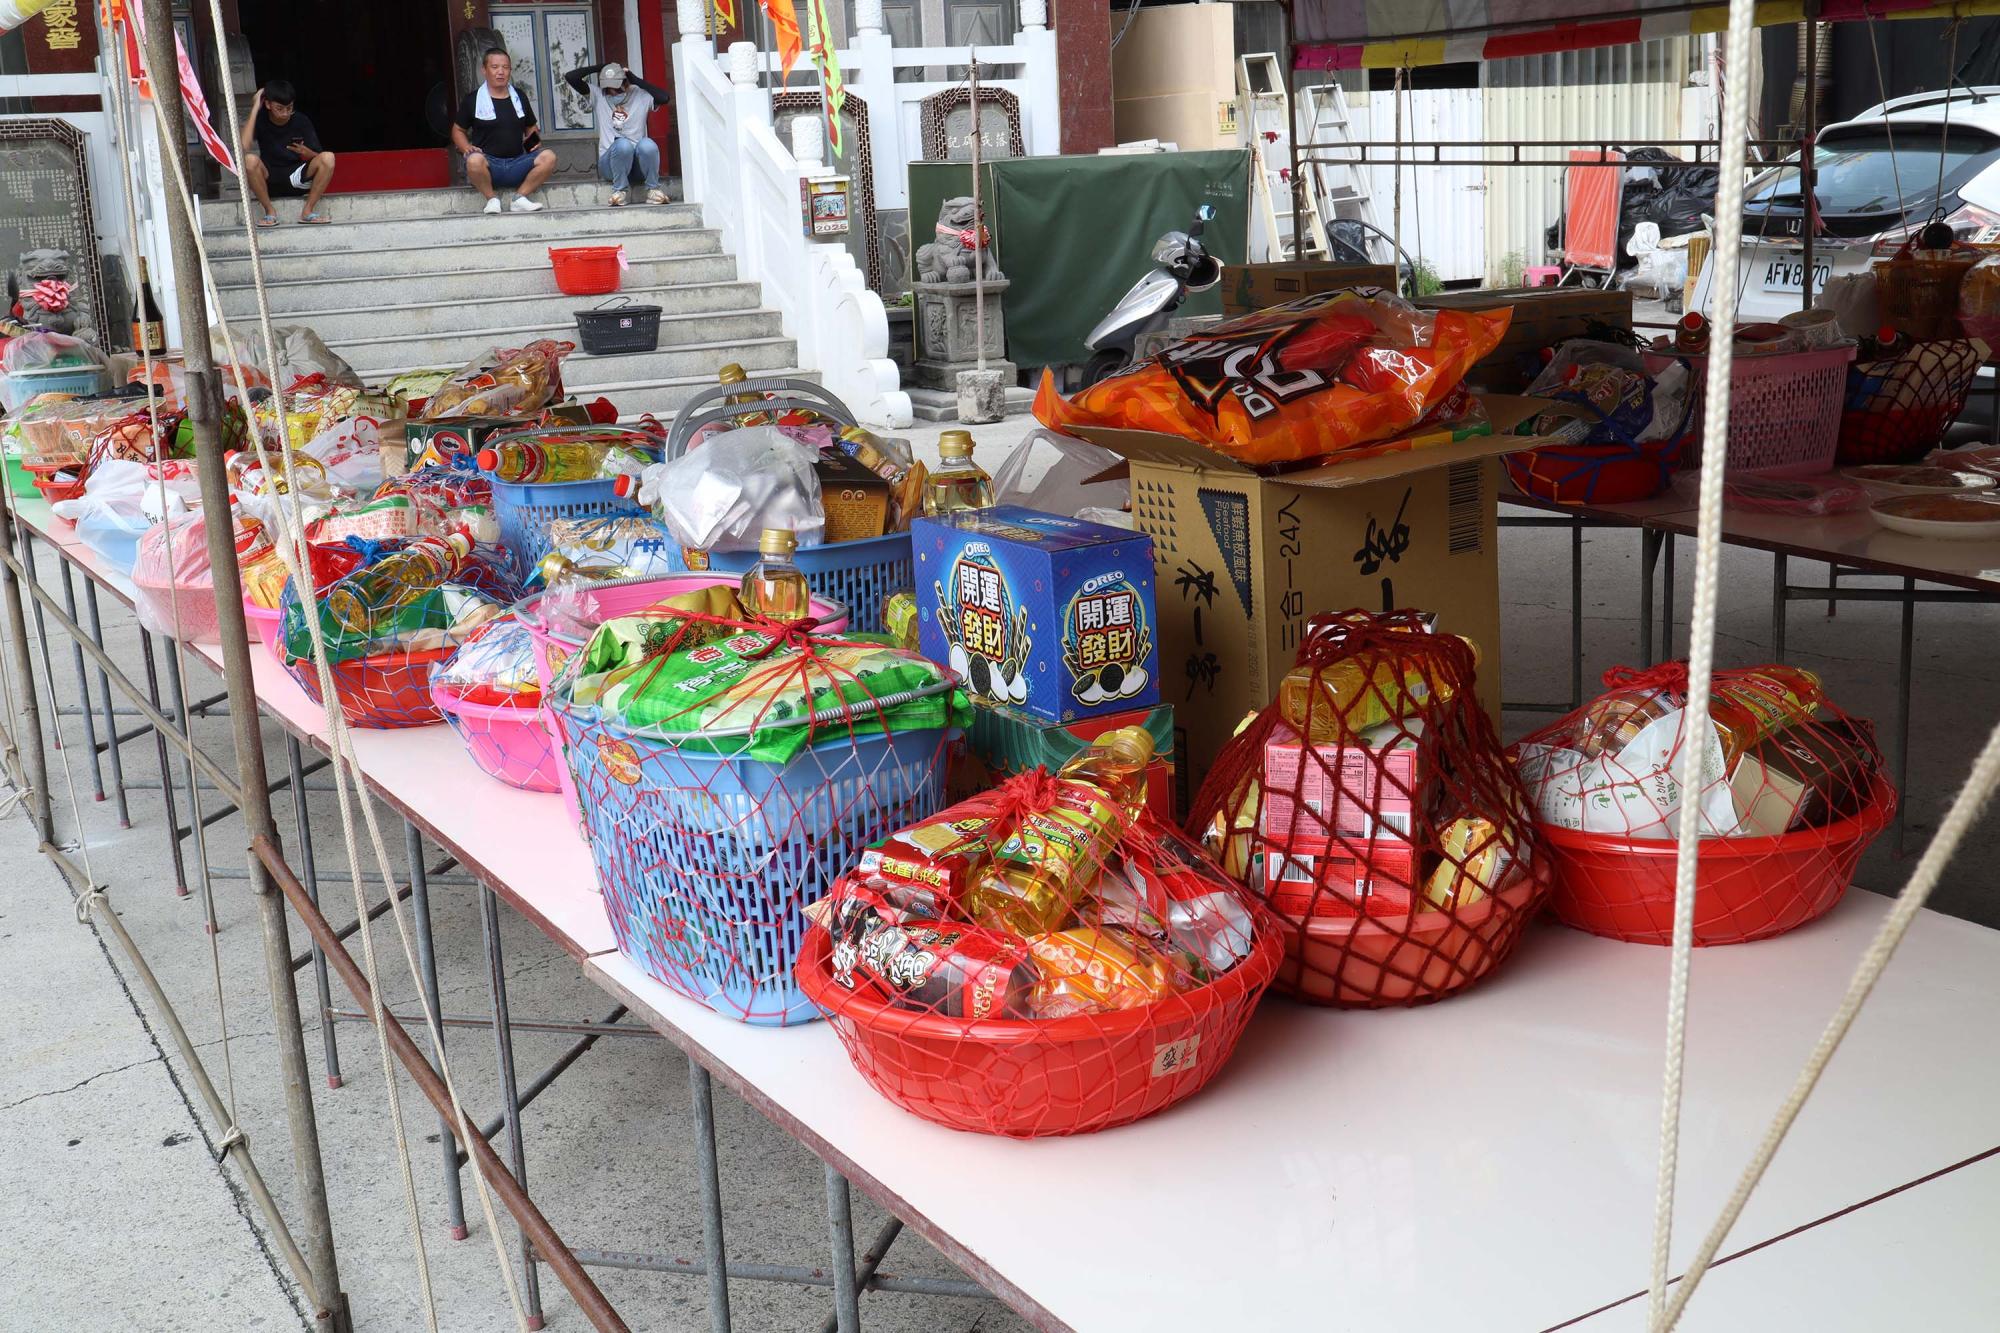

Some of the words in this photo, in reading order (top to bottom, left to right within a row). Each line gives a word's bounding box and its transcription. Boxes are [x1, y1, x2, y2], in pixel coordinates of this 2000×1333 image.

[42, 0, 82, 49] 家香
[1765, 262, 1830, 287] AFW-870
[1214, 500, 1223, 536] Flavor
[1222, 501, 1231, 549] Seafood
[965, 543, 990, 556] OREO
[1230, 502, 1247, 583] 鮮蝦魚板風味
[959, 564, 1001, 612] 開運
[1083, 571, 1123, 593] OREO
[1079, 594, 1131, 631] 開運
[963, 609, 1002, 657] 發財
[1081, 628, 1132, 664] 發財
